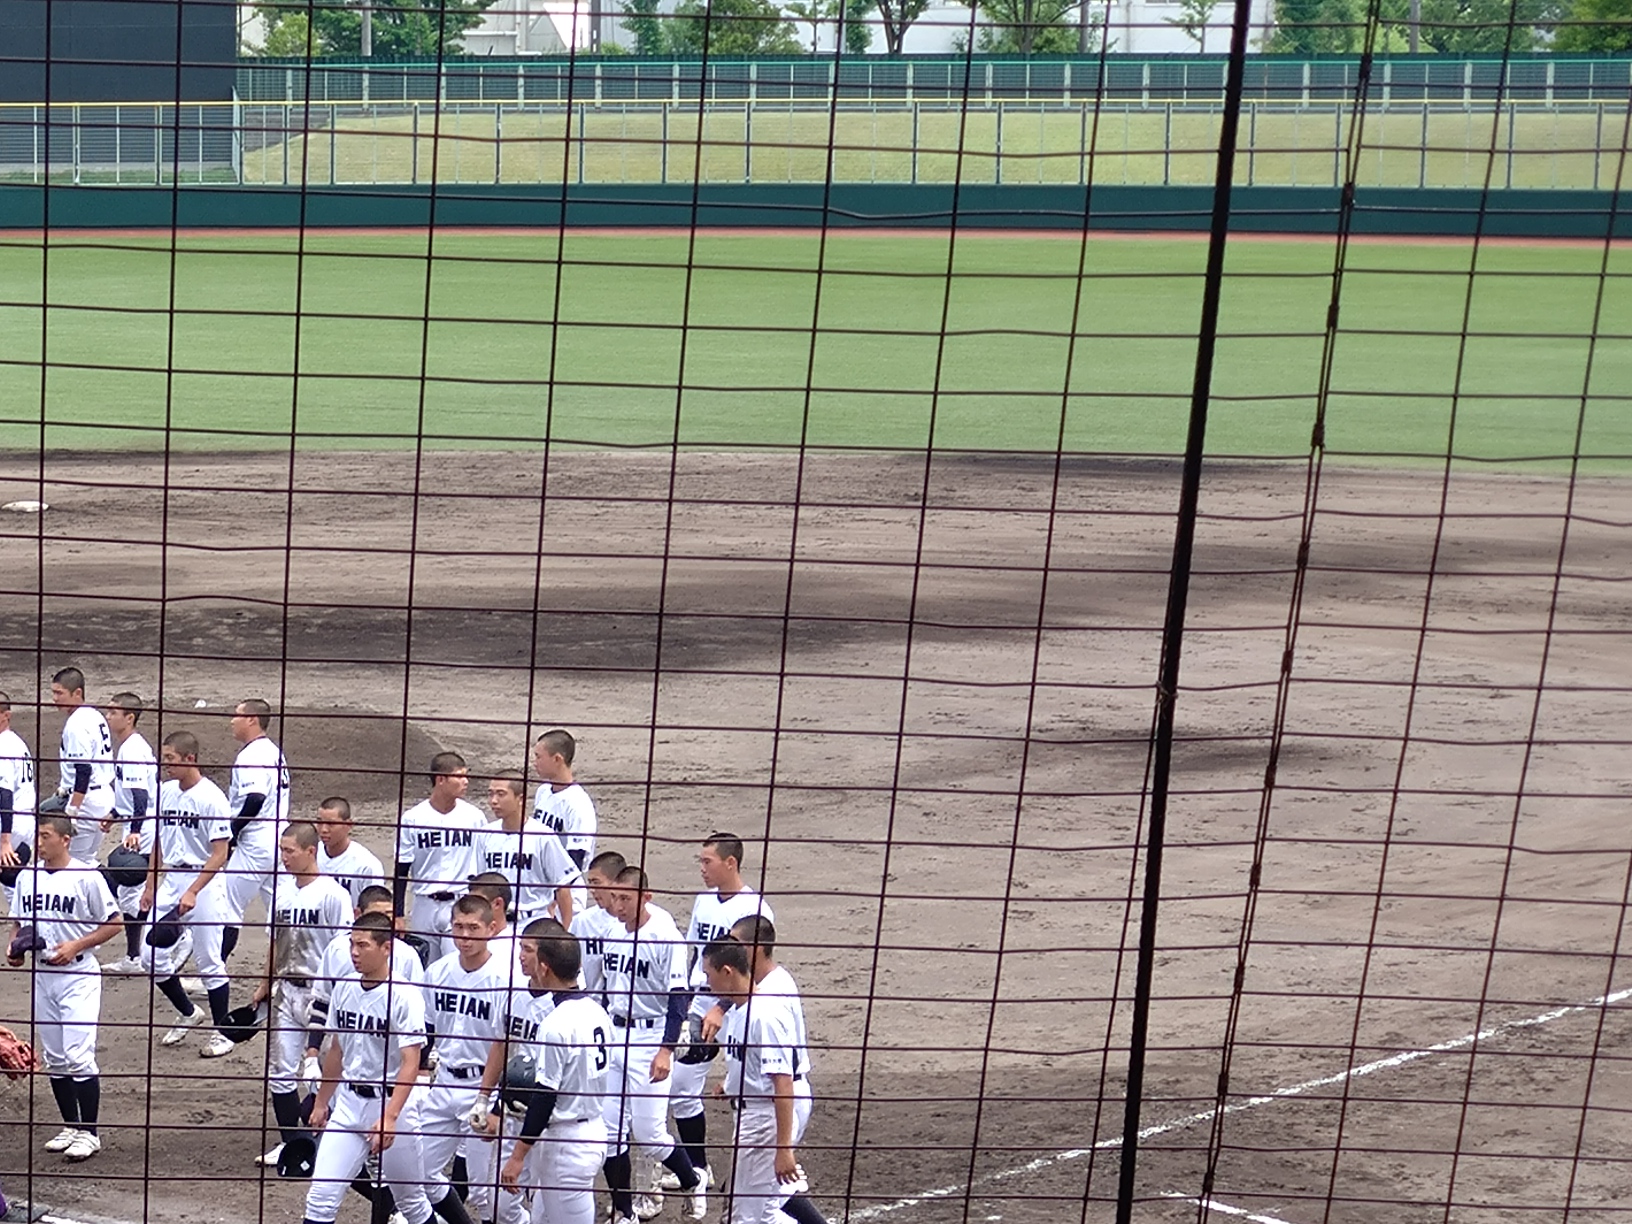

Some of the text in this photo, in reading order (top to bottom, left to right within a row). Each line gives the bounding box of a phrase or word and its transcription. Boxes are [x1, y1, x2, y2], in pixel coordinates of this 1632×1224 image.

[533, 808, 564, 833] EIAN
[418, 829, 473, 848] HEIAN
[485, 851, 533, 871] HEIAN
[22, 893, 76, 915] HEIAN
[603, 951, 650, 979] HEIAN
[434, 991, 491, 1021] HEIAN
[336, 1009, 388, 1038] HEIAN
[593, 1026, 608, 1071] 3
